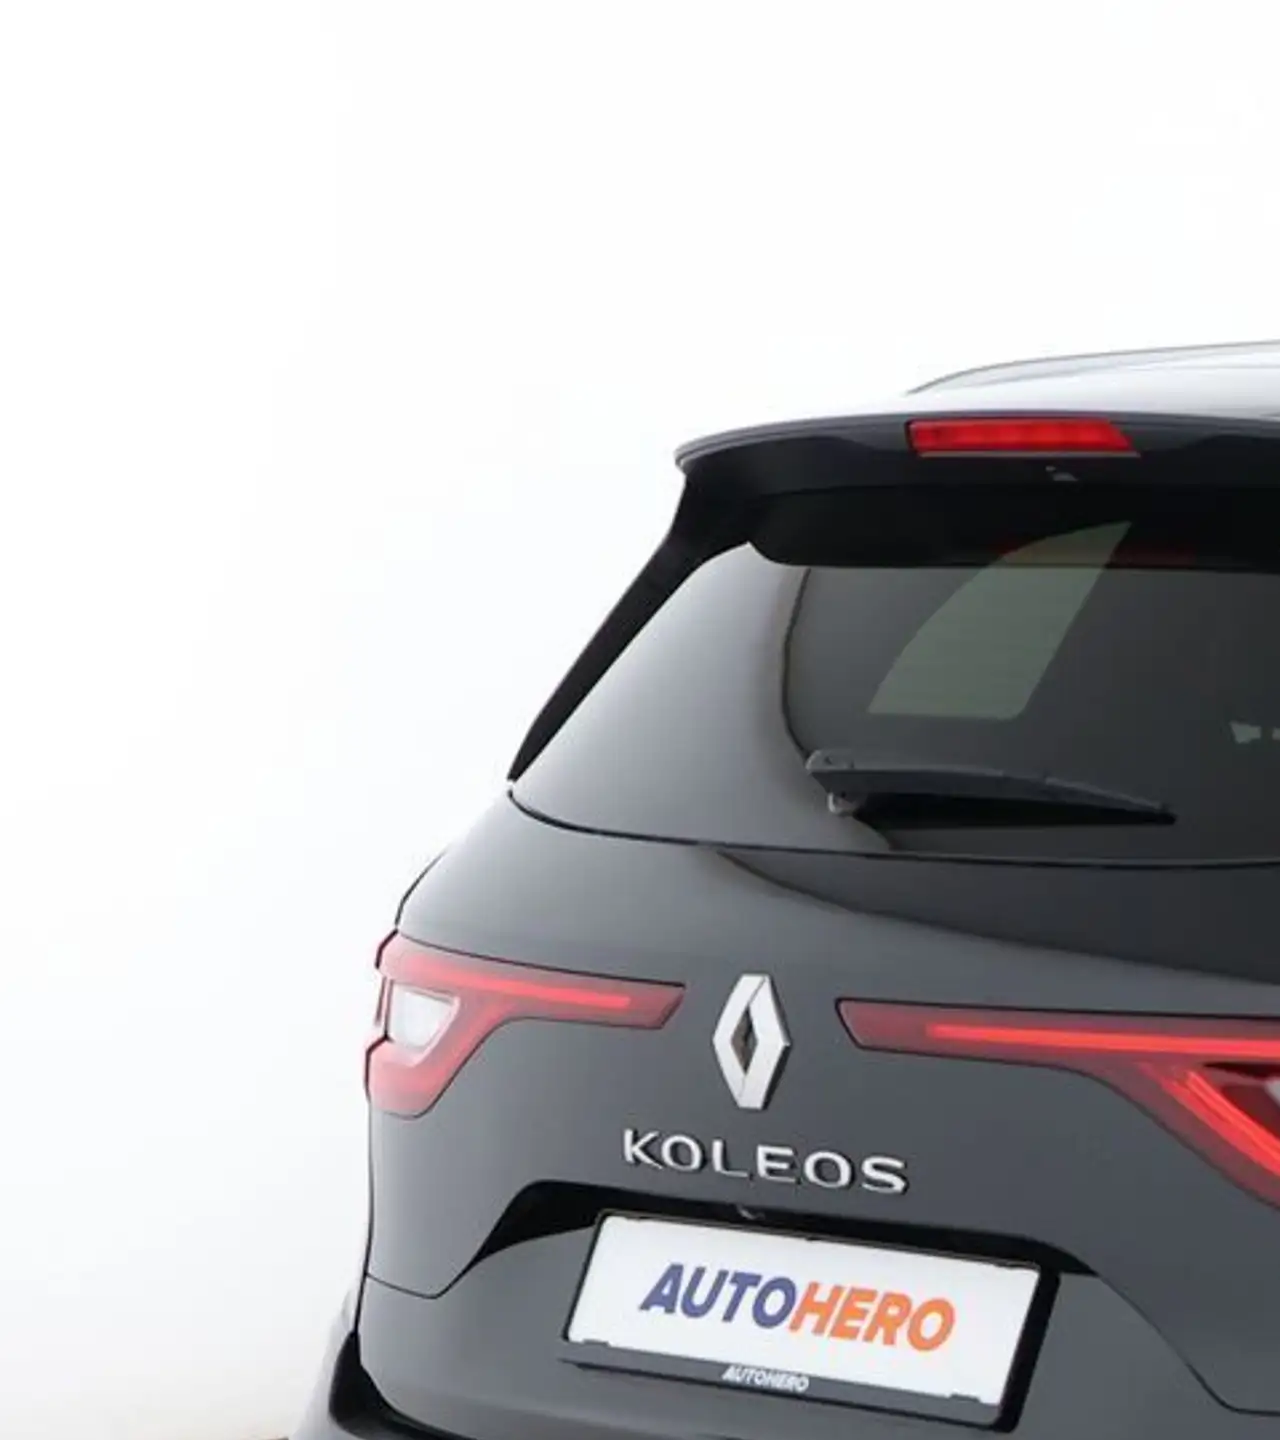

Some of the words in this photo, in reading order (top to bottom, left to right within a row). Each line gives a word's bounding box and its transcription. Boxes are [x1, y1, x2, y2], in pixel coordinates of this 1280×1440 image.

[623, 1129, 908, 1194] KOLEOS
[639, 1263, 956, 1352] AUTOHERO
[721, 1364, 811, 1394] AUTOHERO
